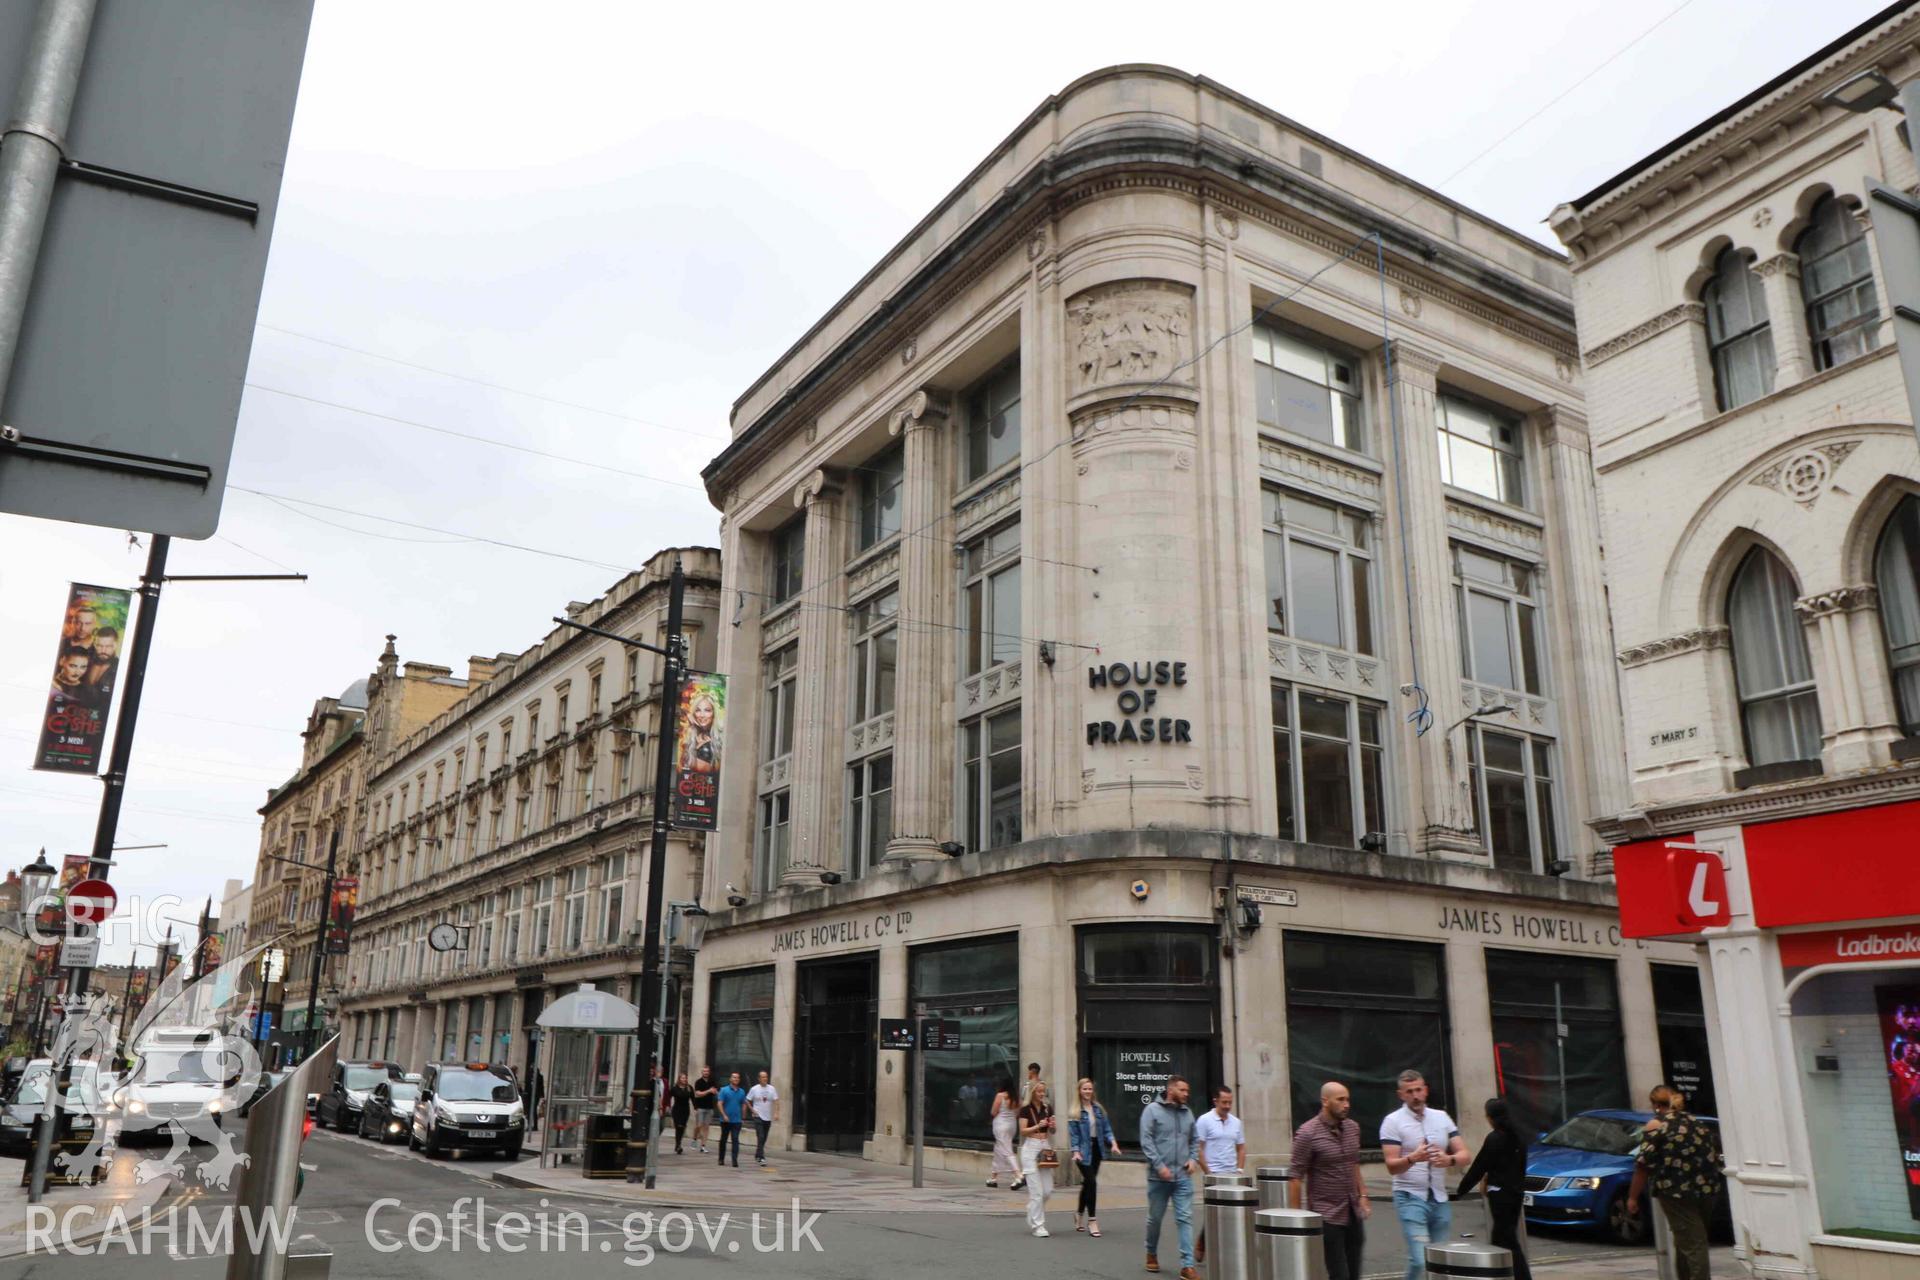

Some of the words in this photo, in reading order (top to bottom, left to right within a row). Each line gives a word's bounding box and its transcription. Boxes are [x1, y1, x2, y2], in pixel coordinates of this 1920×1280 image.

[1089, 661, 1187, 689] HOUSE
[1117, 689, 1157, 714] OF
[1087, 718, 1192, 745] FRASER
[1661, 730, 1685, 744] MARY
[772, 929, 805, 952] JAMES
[811, 920, 859, 947] HOWELL
[1438, 907, 1502, 935] JAMES
[1513, 914, 1588, 944] HOWELL
[1120, 1052, 1170, 1063] HOWELLS
[1115, 1072, 1136, 1081] Store
[1124, 1083, 1138, 1092] The
[1140, 1084, 1166, 1093] Hayes
